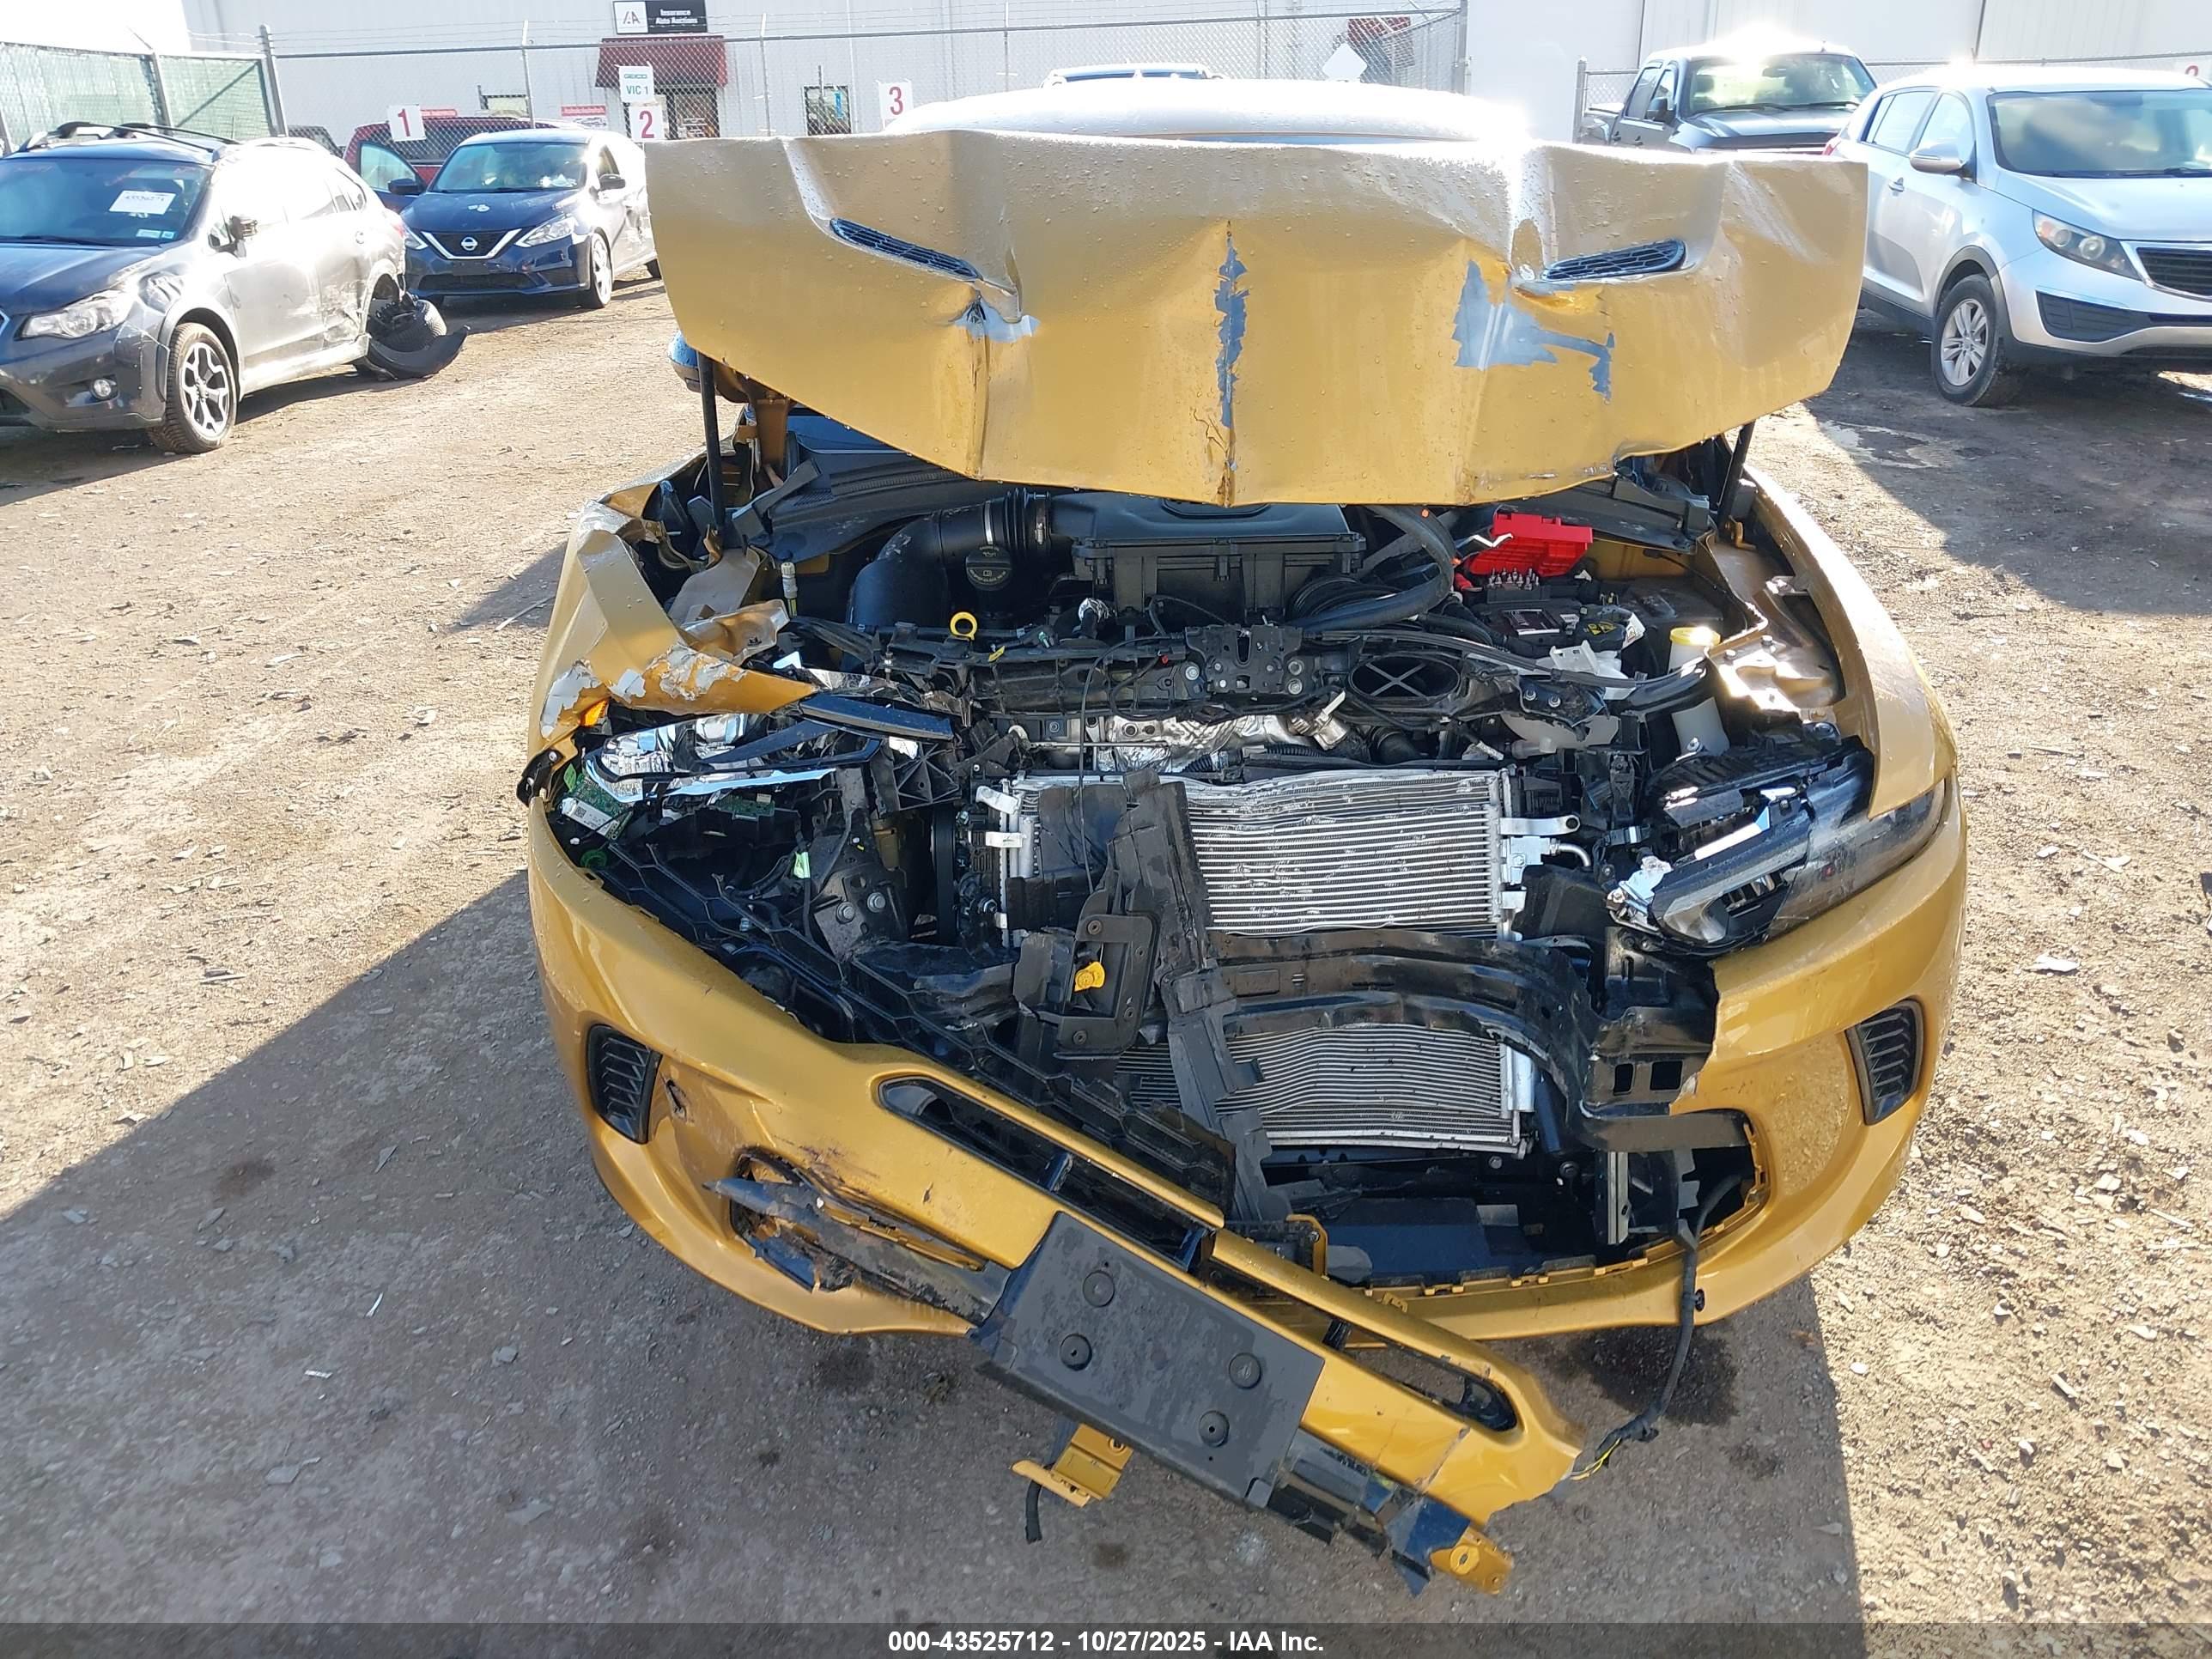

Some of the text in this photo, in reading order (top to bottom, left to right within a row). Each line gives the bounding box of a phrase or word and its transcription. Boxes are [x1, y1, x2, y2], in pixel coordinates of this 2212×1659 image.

[625, 86, 649, 95] VIC 1
[888, 86, 904, 116] 3
[397, 108, 411, 137] 1
[639, 110, 655, 139] 2
